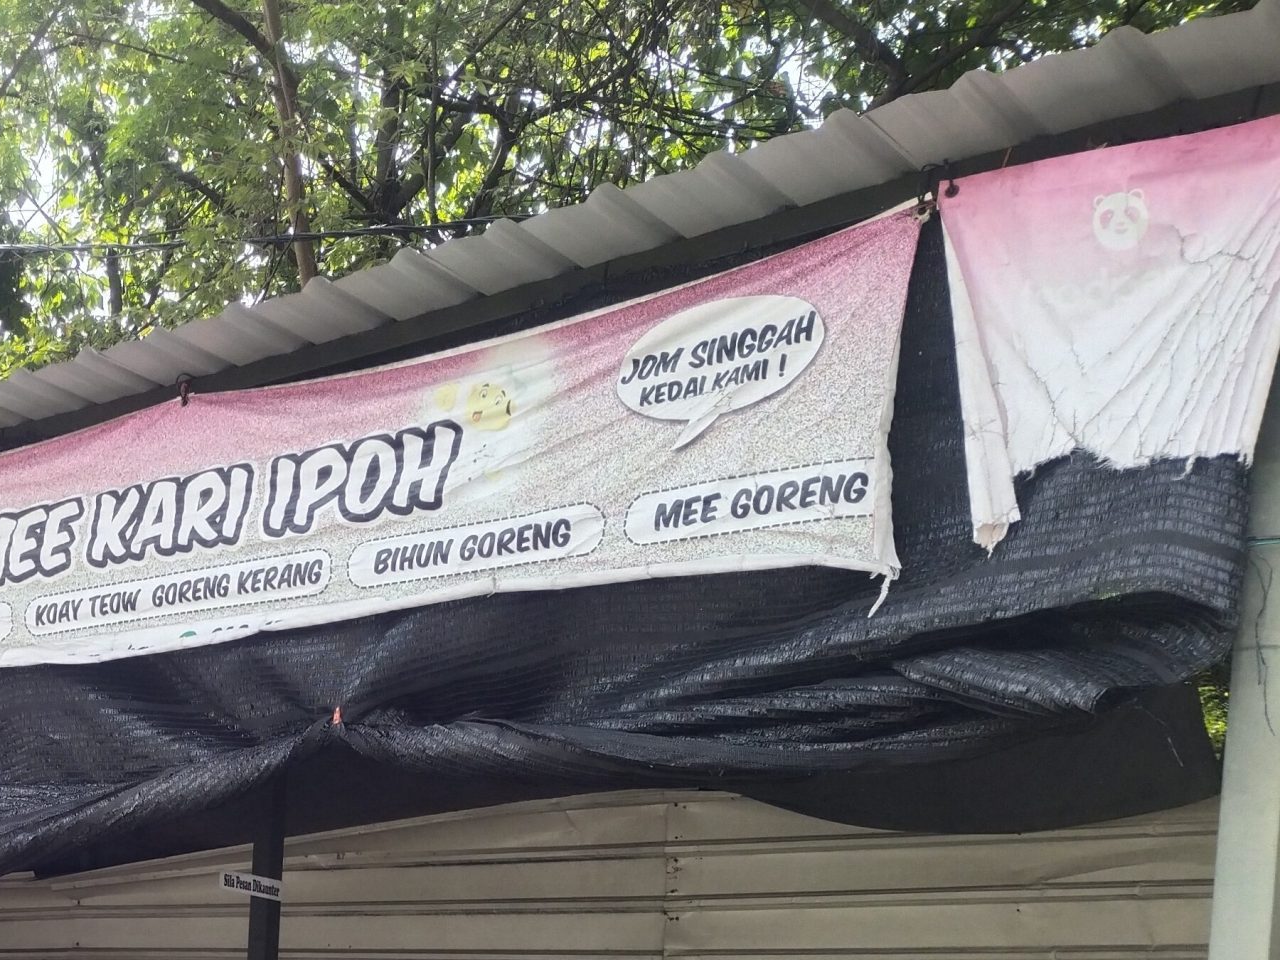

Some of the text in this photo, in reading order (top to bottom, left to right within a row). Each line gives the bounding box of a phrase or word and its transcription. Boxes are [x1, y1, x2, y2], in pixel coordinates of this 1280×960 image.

[620, 310, 816, 385] JOM SINGGAH
[639, 377, 707, 407] KEDAI
[712, 358, 770, 391] KAMI
[87, 463, 255, 568] KARI
[263, 419, 463, 538] IPOH
[654, 472, 869, 531] MEE GORENG
[374, 518, 571, 576] BIHUN GORENG
[35, 563, 322, 627] KOAY TEOW GORENG KERANG
[223, 873, 235, 888] Sila
[235, 875, 252, 892] Pesan
